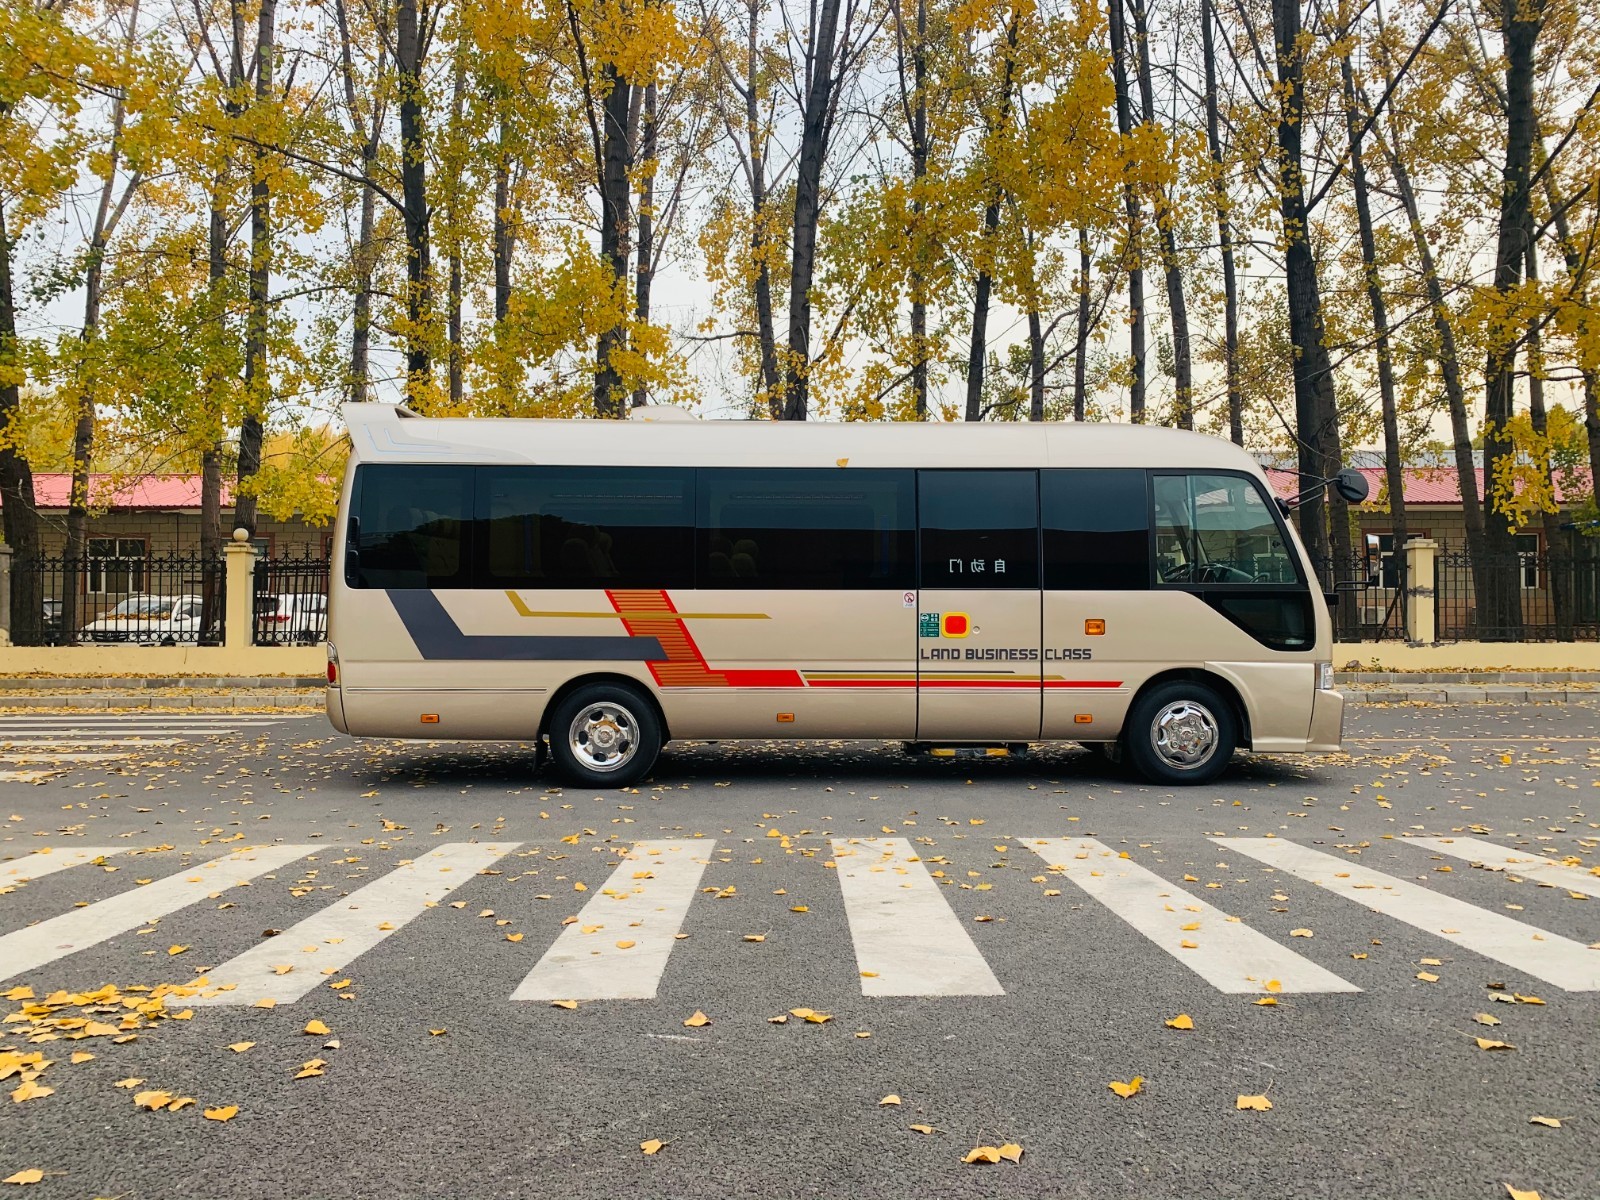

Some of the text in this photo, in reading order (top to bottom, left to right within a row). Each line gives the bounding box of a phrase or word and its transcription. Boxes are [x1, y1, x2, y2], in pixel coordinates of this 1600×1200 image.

[920, 648, 1092, 660] LAND BUSINESS CLASS
